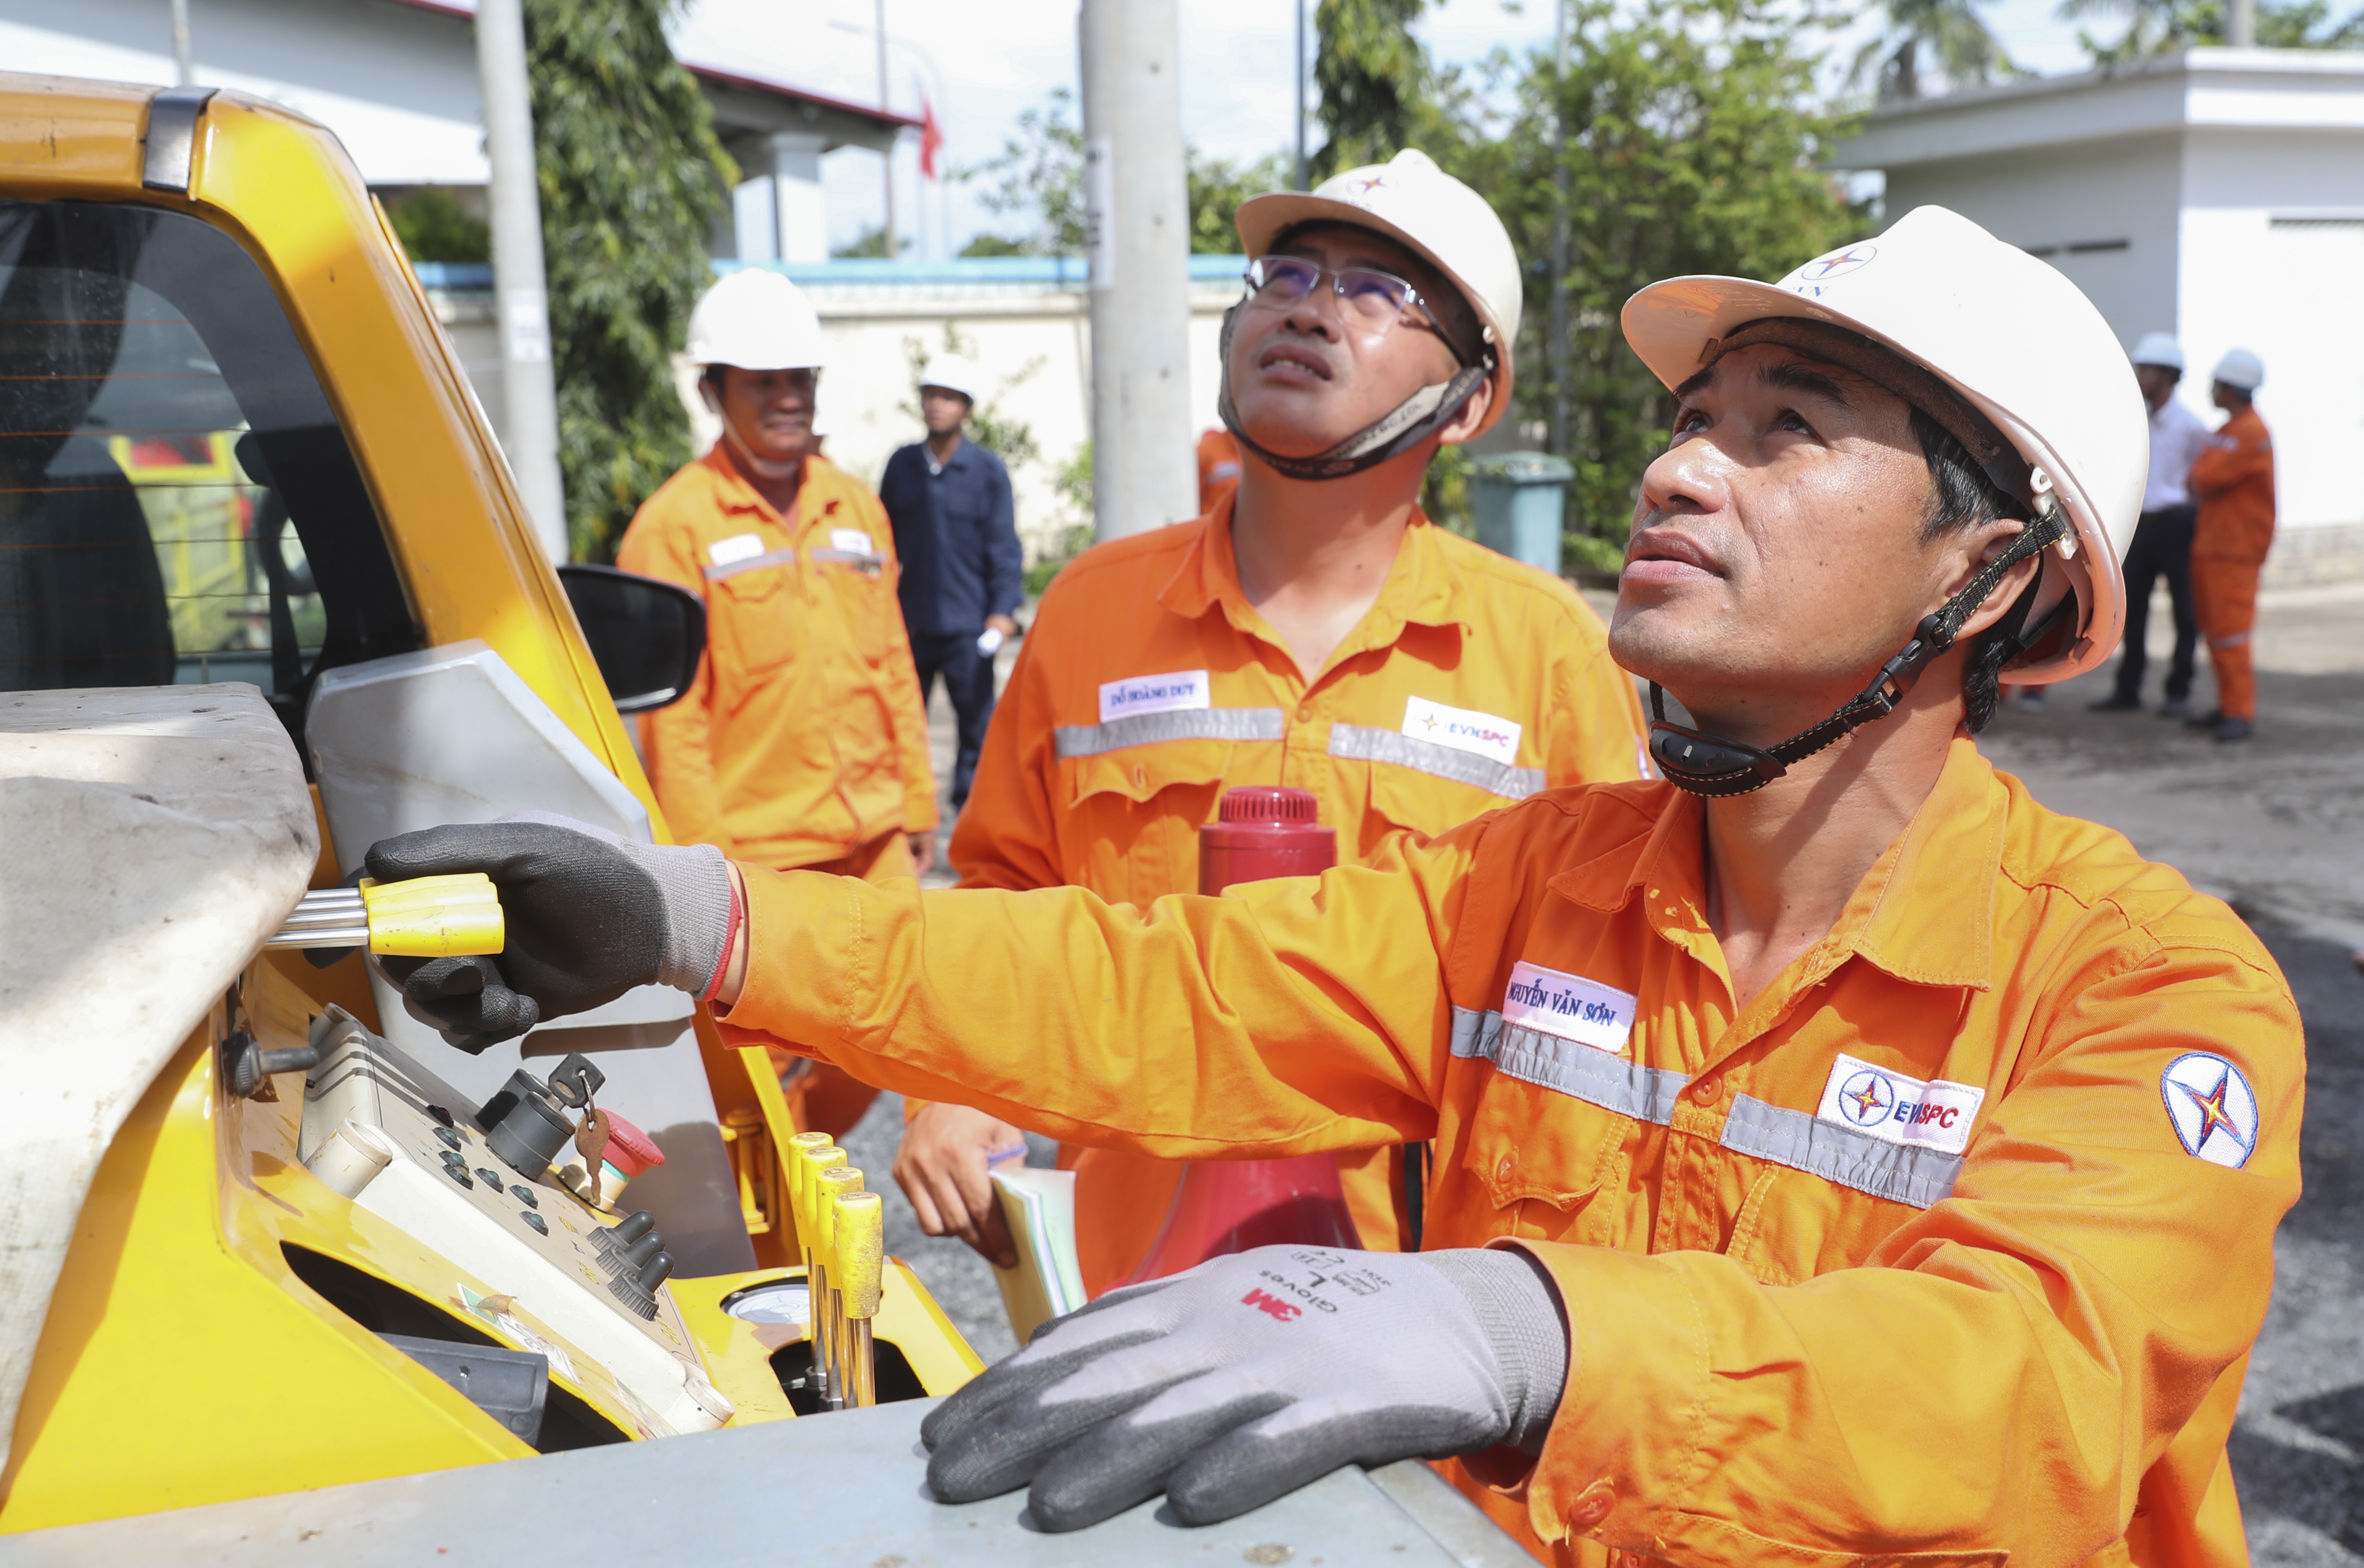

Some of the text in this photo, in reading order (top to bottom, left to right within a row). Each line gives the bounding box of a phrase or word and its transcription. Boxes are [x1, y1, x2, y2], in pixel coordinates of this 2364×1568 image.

[1787, 286, 1829, 297] VN
[1449, 723, 1509, 747] EVNSPC
[1552, 988, 1582, 1016] VĂN
[1259, 1270, 1337, 1312] Gloves
[1308, 1271, 1327, 1287] L
[1241, 1287, 1302, 1323] 3M
